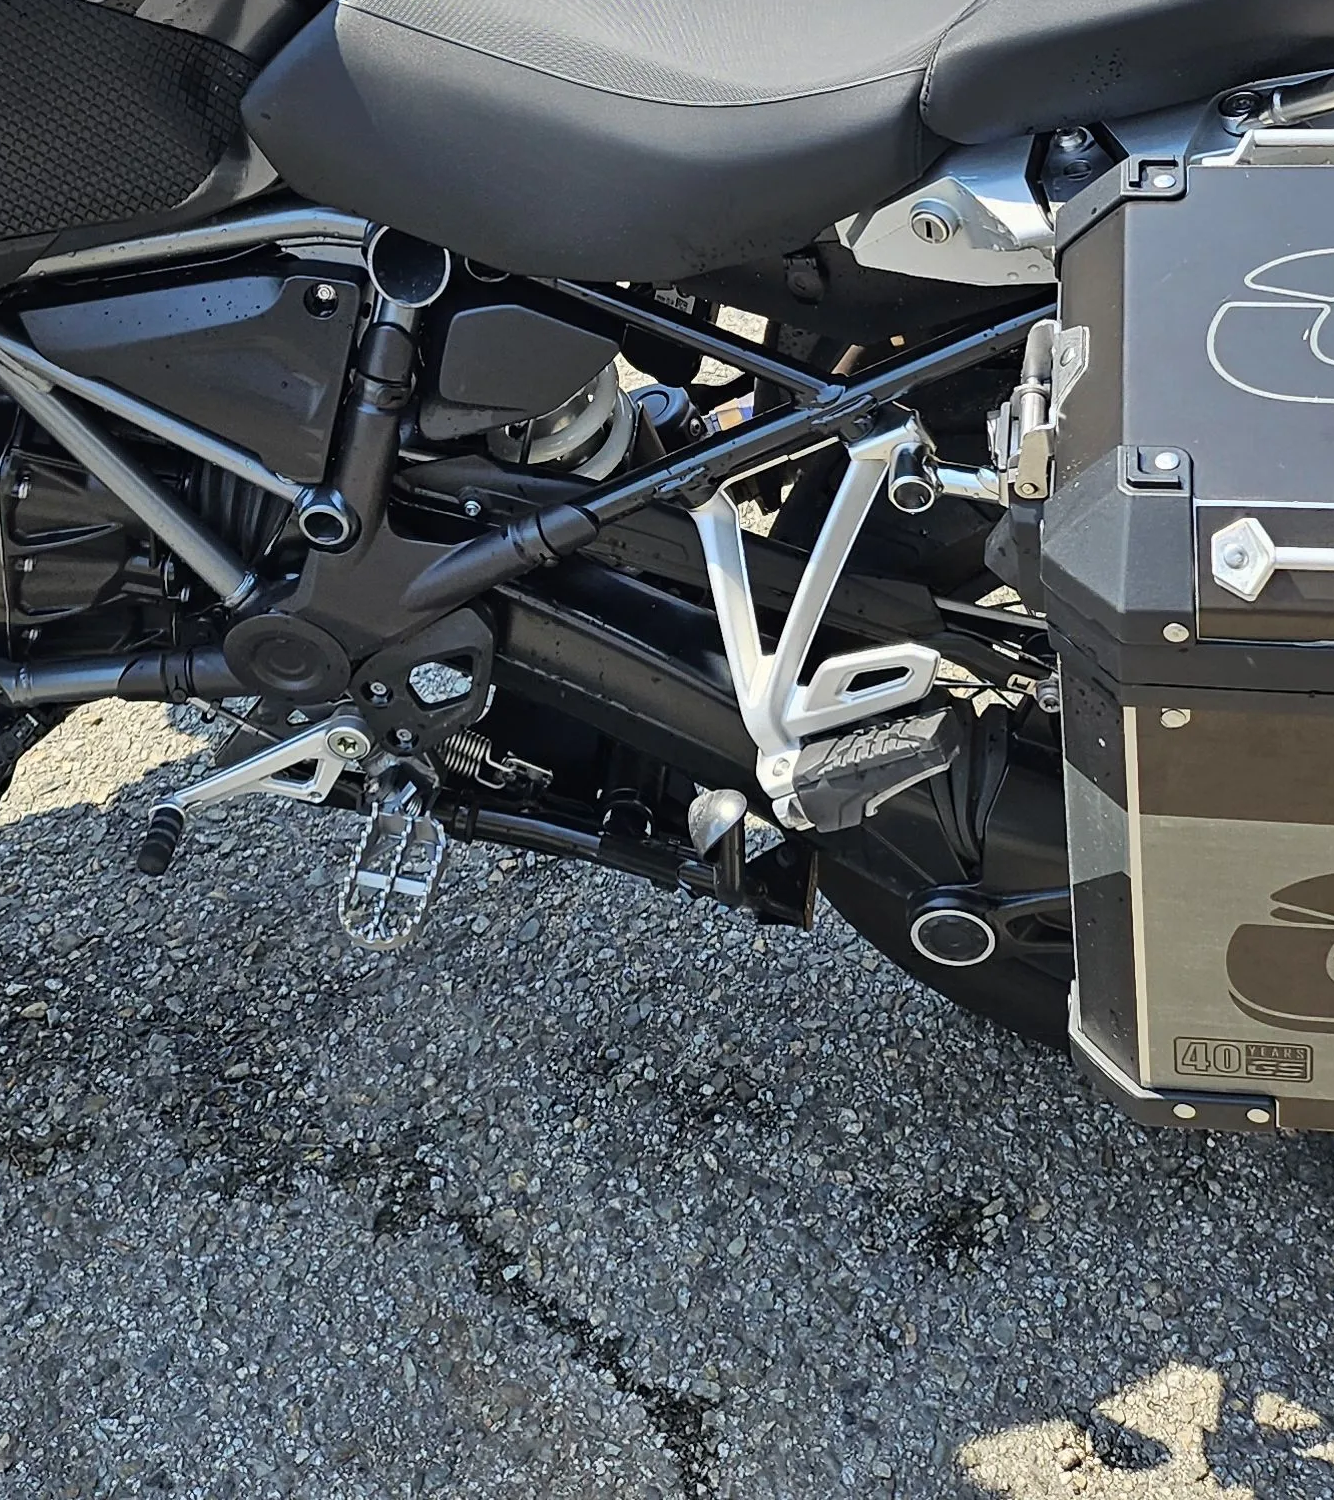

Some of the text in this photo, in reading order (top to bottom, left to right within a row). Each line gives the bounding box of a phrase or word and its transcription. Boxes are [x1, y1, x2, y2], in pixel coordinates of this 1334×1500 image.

[1182, 1041, 1306, 1073] 40 YEARS
[1247, 1059, 1306, 1077] GS
